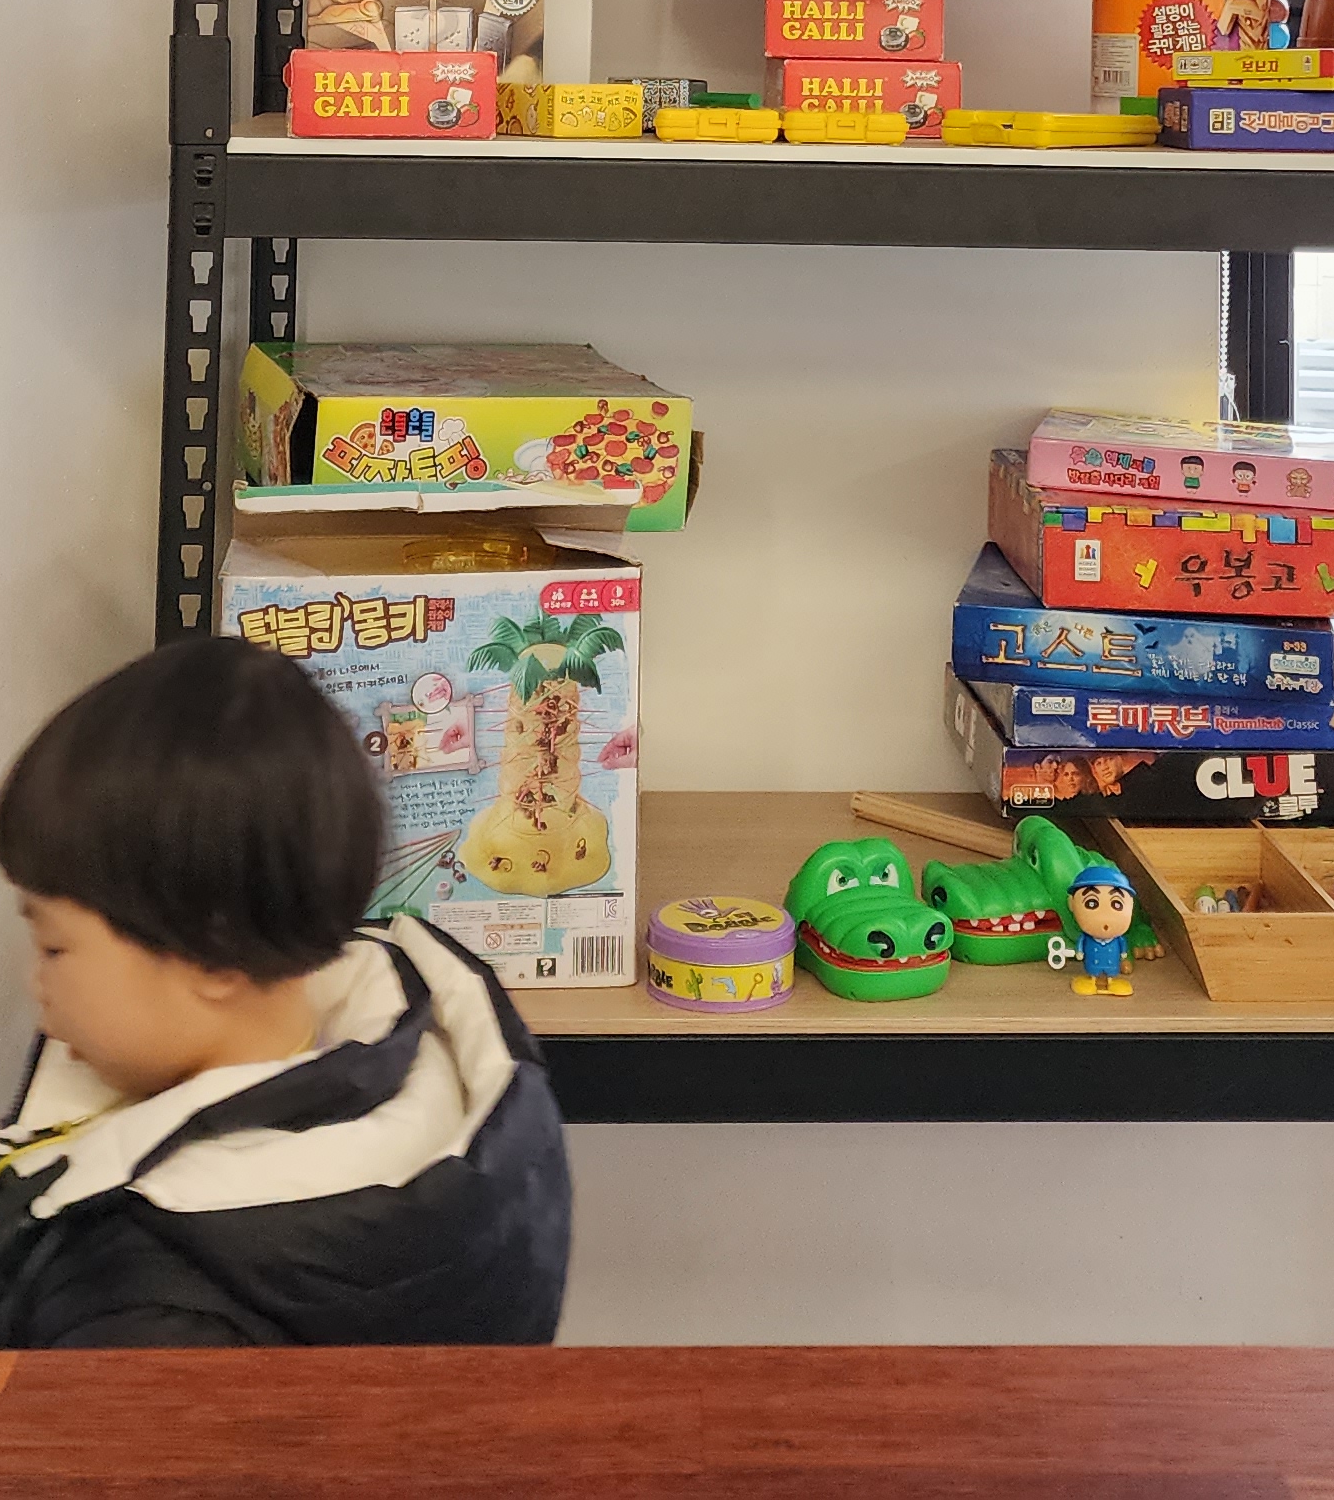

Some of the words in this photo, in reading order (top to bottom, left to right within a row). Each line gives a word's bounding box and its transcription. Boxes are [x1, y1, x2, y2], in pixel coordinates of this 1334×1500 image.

[782, 0, 866, 20] HALLI
[1152, 2, 1195, 24] 설명이
[782, 21, 866, 41] GALLI
[1150, 23, 1175, 39] 필요
[1175, 20, 1201, 36] 없는
[1148, 37, 1175, 56] 국민
[1175, 34, 1207, 52] 게임!
[314, 71, 411, 93] HALLI
[440, 68, 469, 76] AMIGO
[801, 77, 884, 97] HALLI
[313, 95, 411, 118] GALLI
[380, 408, 435, 443] 흔들흔들
[1102, 472, 1137, 489] 사다리
[1175, 548, 1302, 600] 우봉고
[352, 597, 427, 648] 몽키
[981, 621, 1143, 678] 고스트
[339, 663, 380, 675] 나무에서
[1086, 702, 1213, 739] 루미큐브
[1286, 719, 1320, 730] Classic
[369, 737, 382, 752] 2
[1195, 753, 1317, 800] CLUE
